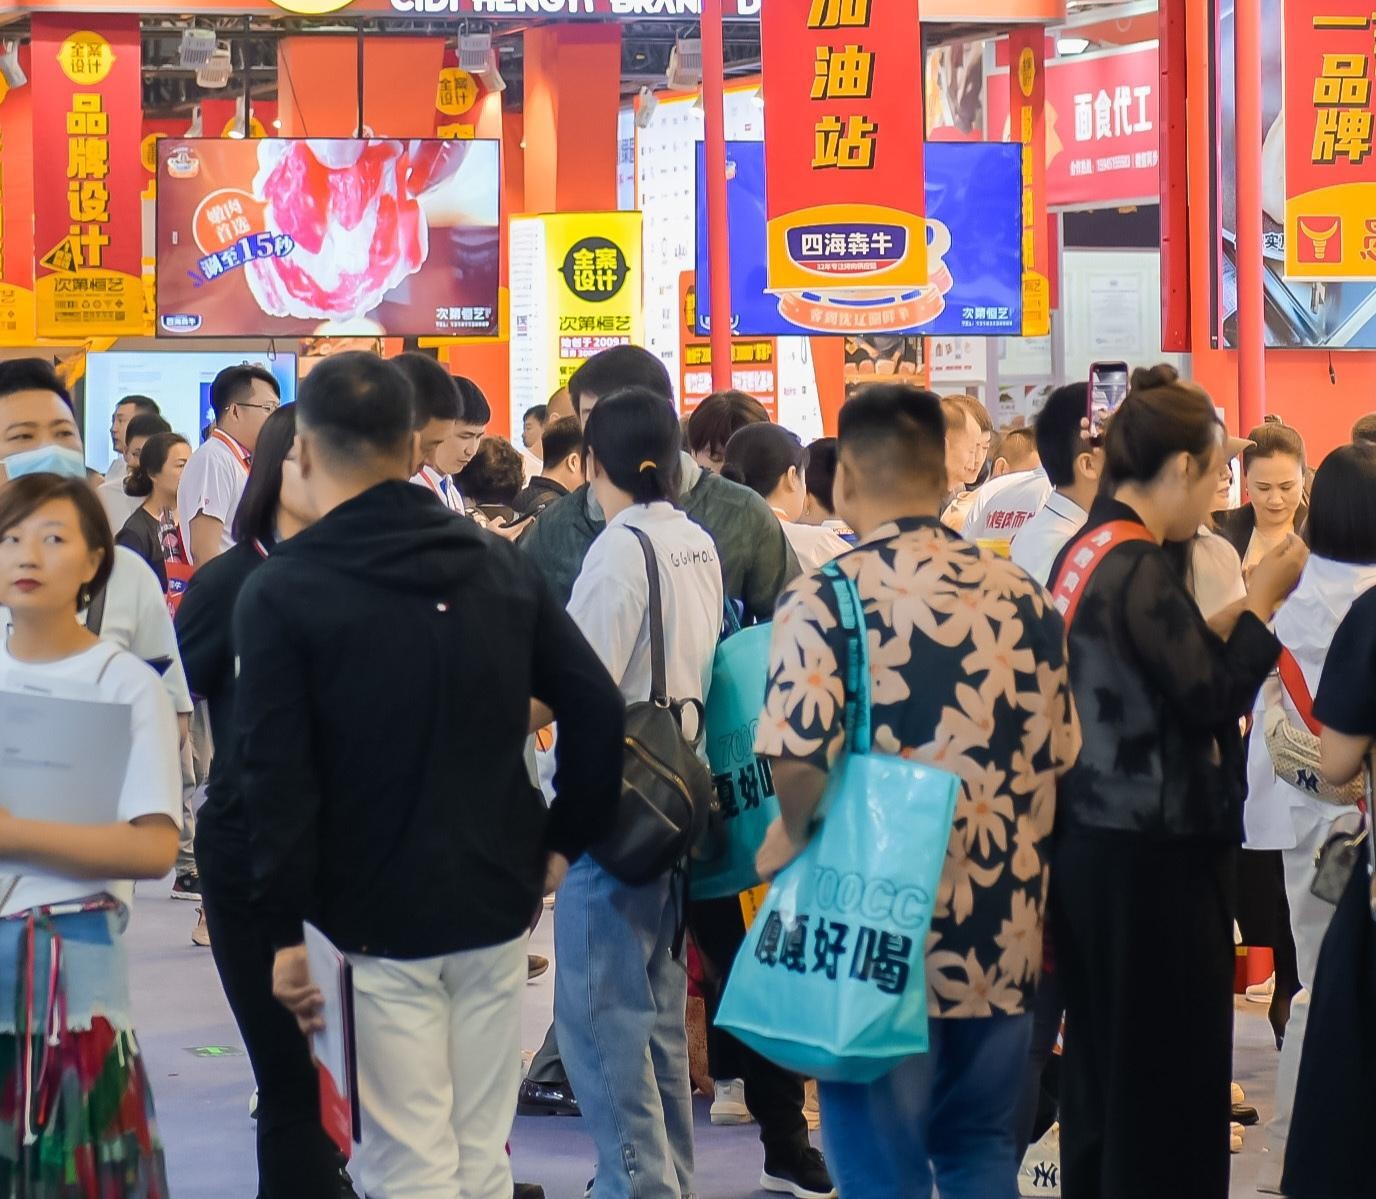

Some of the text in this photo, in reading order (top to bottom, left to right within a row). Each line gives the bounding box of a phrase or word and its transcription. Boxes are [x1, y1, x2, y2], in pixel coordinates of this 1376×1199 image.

[1073, 85, 1153, 142] 面食代工
[67, 93, 110, 267] 品牌设计
[801, 232, 893, 257] 四海犇牛
[573, 247, 617, 270] 全案
[53, 277, 125, 293] 次第恒艺
[573, 270, 617, 292] 设计
[559, 315, 631, 331] 次第恒艺
